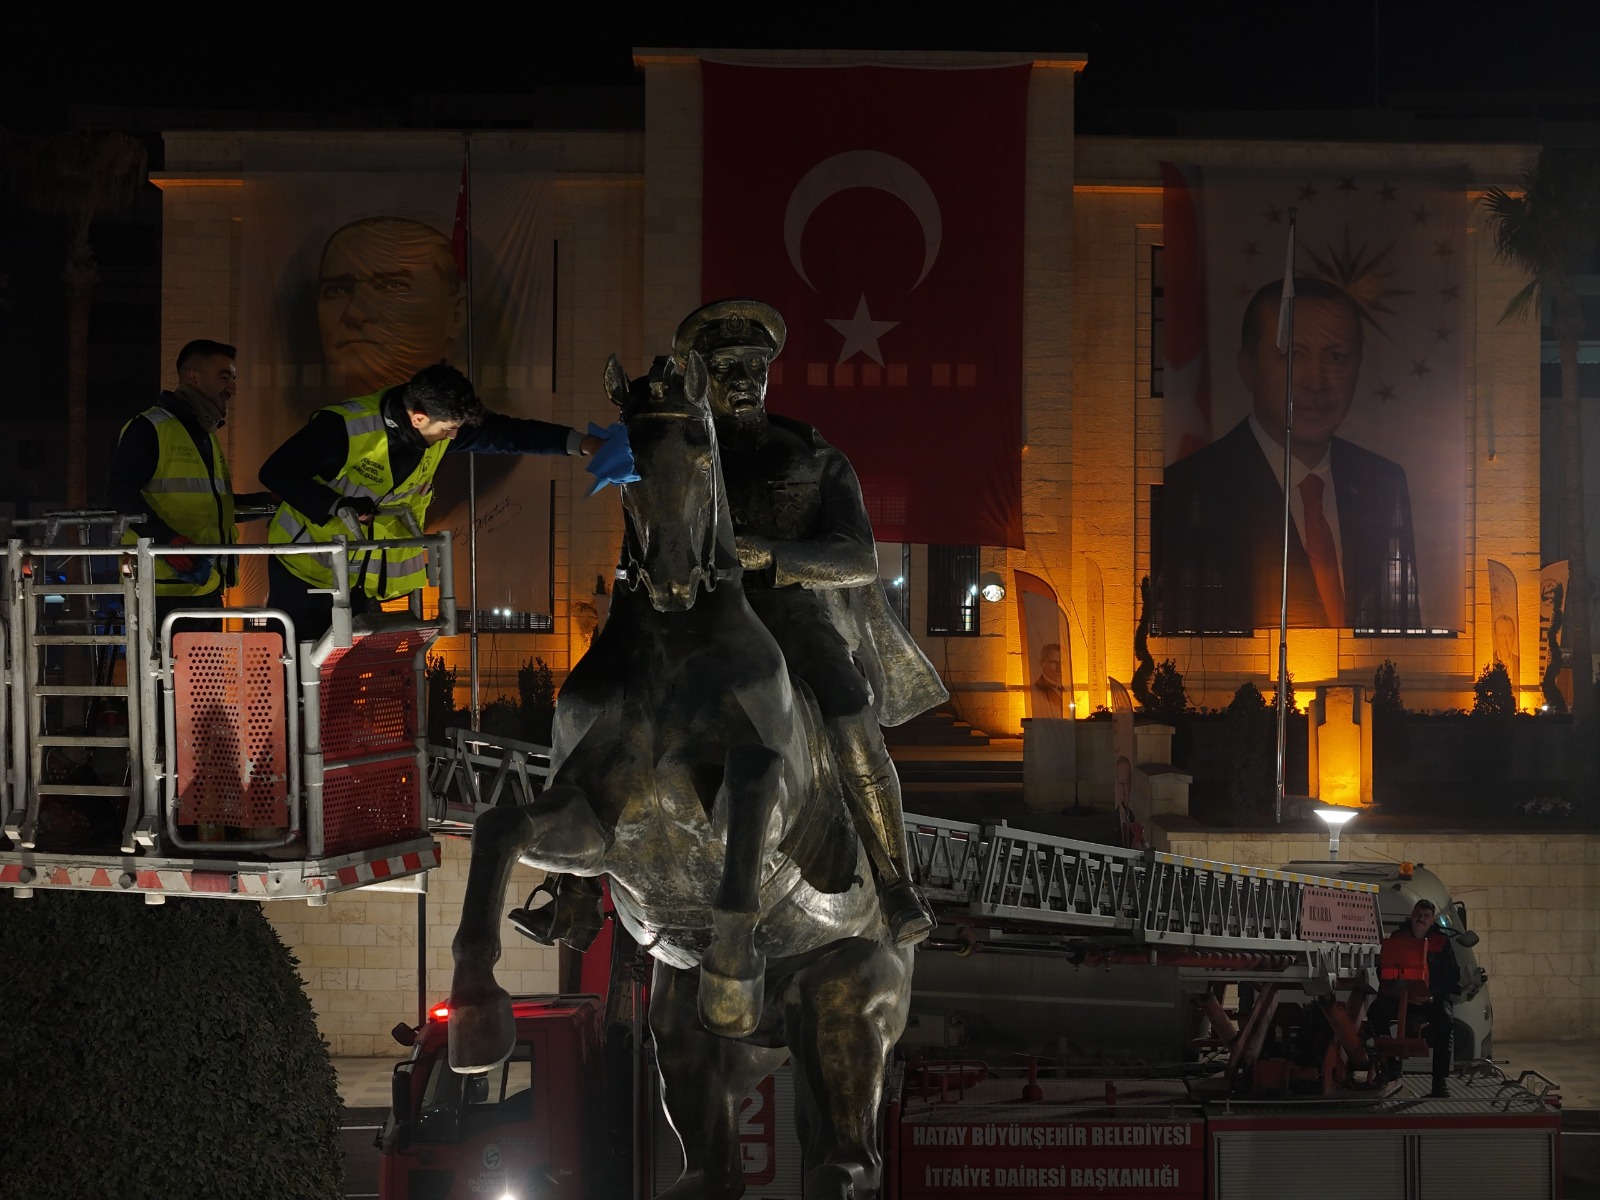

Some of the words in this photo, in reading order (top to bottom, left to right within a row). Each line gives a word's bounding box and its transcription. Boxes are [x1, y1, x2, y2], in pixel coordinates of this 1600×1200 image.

[913, 1125, 967, 1146] HATAY
[971, 1123, 1087, 1149] BÜYÜKŞEHİR
[1091, 1123, 1192, 1146] BELEDİYESİ
[925, 1164, 991, 1188] İTFAİYE
[995, 1164, 1067, 1188] DAİRESİ
[1070, 1163, 1180, 1191] BAŞKANLIĞI
